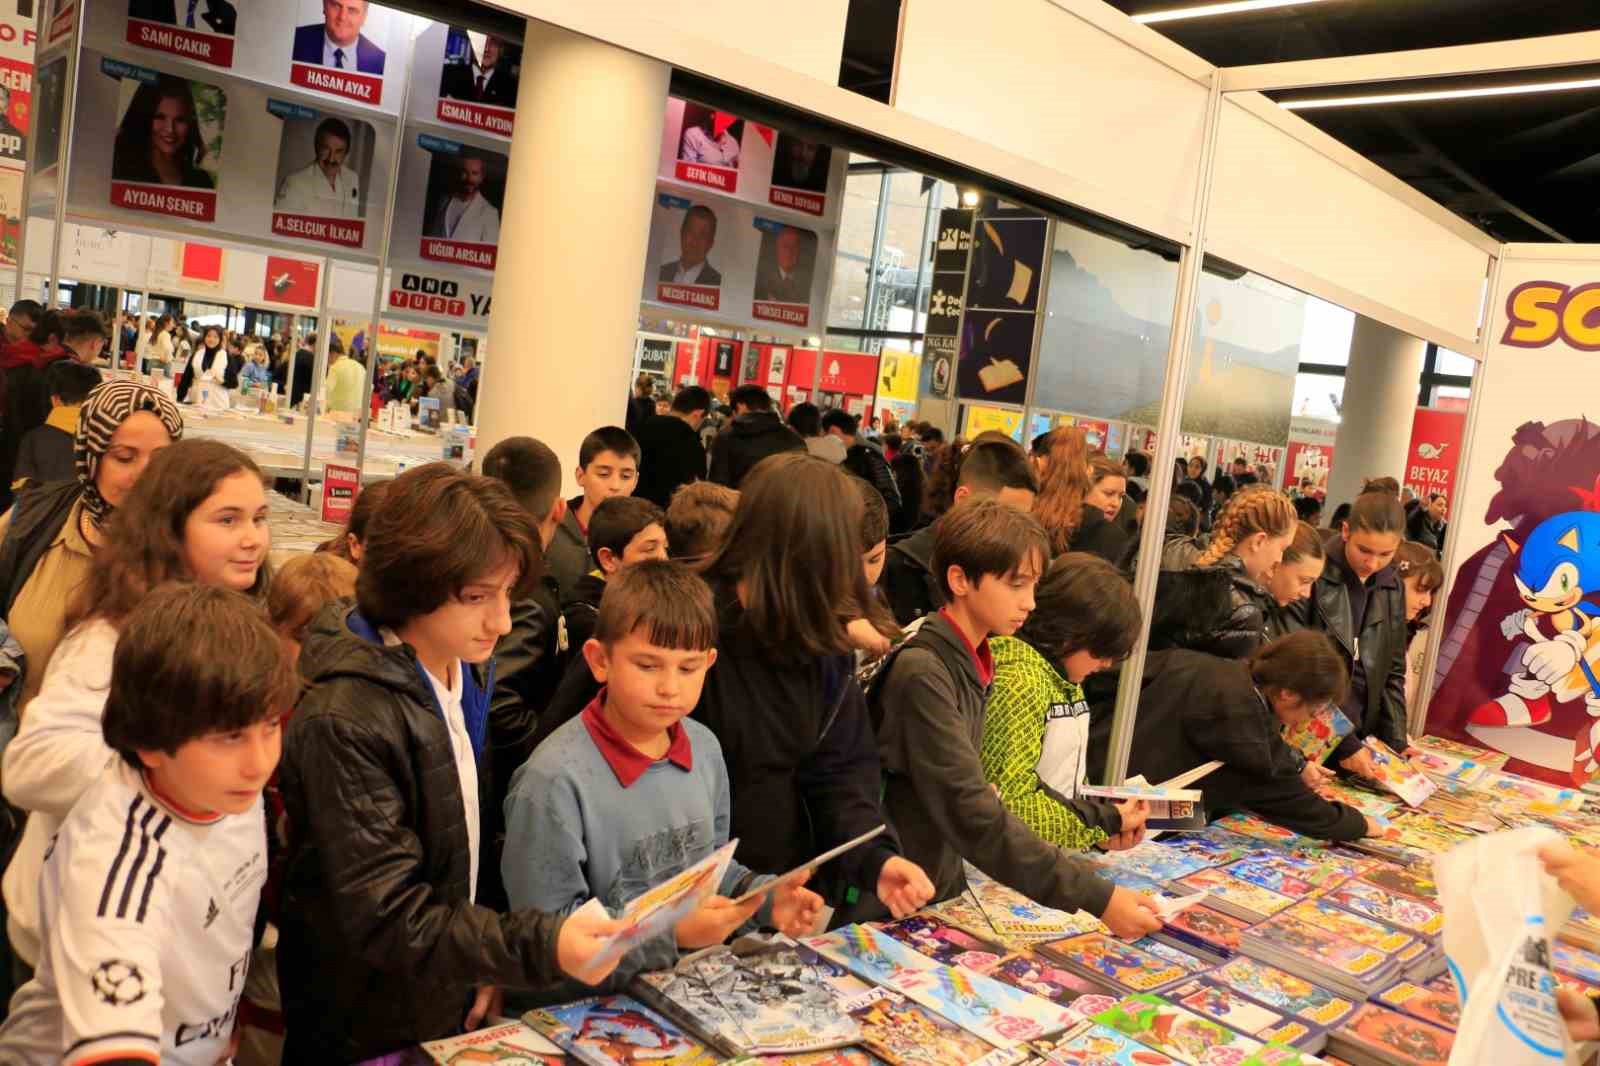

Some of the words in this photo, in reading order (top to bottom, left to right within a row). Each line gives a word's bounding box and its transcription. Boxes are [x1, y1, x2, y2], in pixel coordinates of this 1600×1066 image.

[307, 70, 344, 91] HASAN
[344, 80, 373, 99] AYAZ
[123, 189, 165, 209] AYDAN
[429, 241, 454, 258] UĞUR
[453, 246, 492, 265] ARSLAN
[406, 277, 456, 296] ANA
[391, 291, 463, 314] YURT
[1409, 465, 1449, 485] BEYAZ
